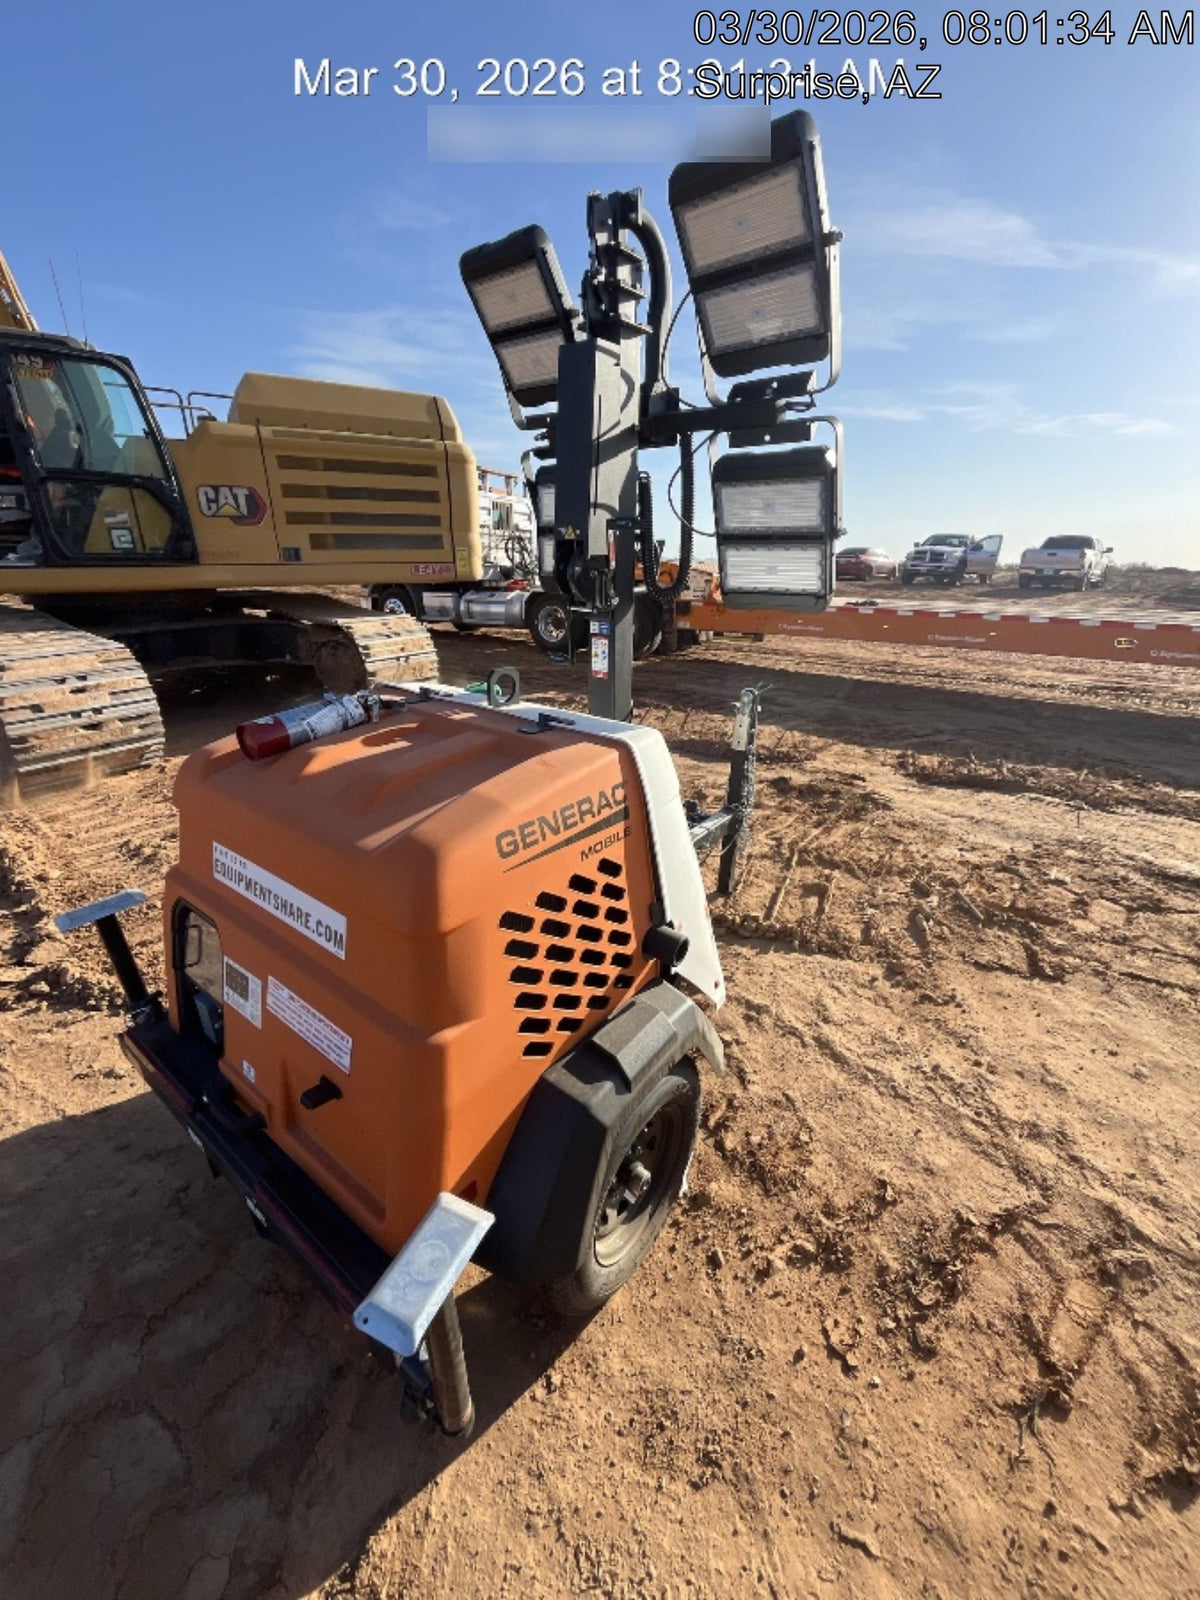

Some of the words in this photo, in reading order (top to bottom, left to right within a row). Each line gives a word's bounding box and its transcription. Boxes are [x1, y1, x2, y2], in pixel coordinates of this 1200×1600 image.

[198, 486, 249, 517] CAT
[496, 781, 628, 859] GENERAC
[580, 826, 632, 862] MOBILE
[214, 858, 344, 952] EQUIPMENTSHARE.COM
